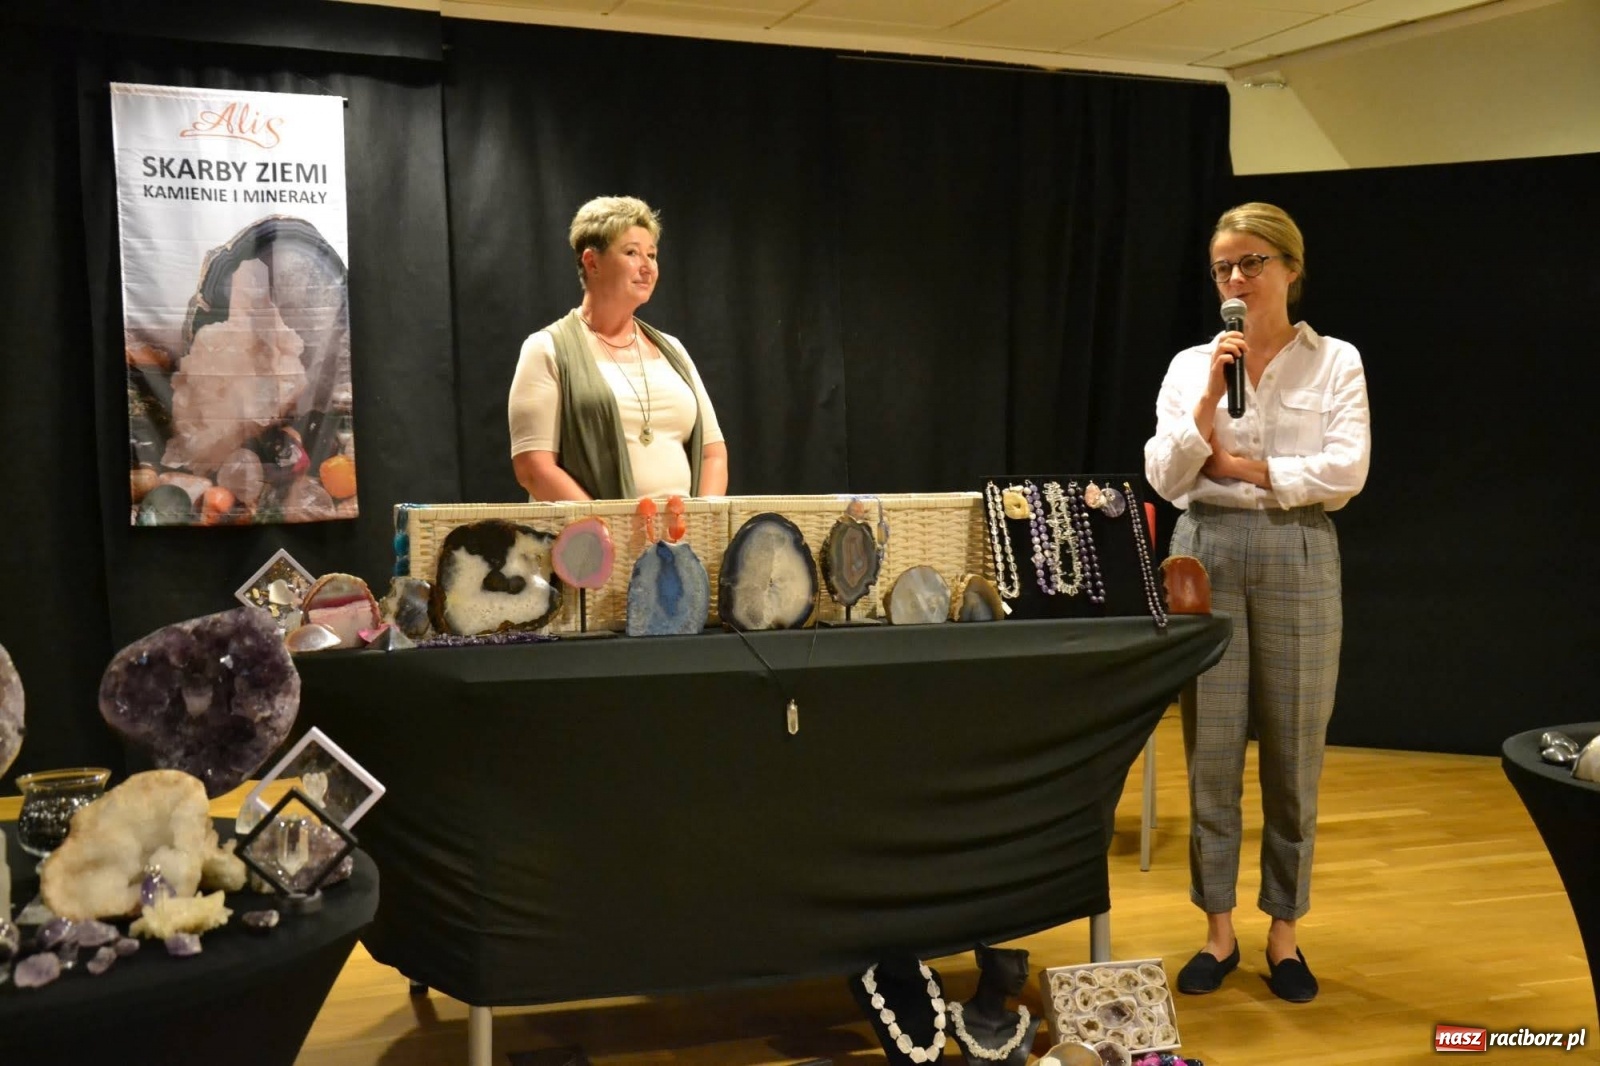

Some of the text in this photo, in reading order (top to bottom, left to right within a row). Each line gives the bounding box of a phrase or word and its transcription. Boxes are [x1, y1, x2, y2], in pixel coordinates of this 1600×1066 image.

[180, 102, 284, 149] Alis
[142, 156, 327, 184] SKARBY ZIEMI
[143, 184, 327, 204] KAMIENIE I MINERAŁY
